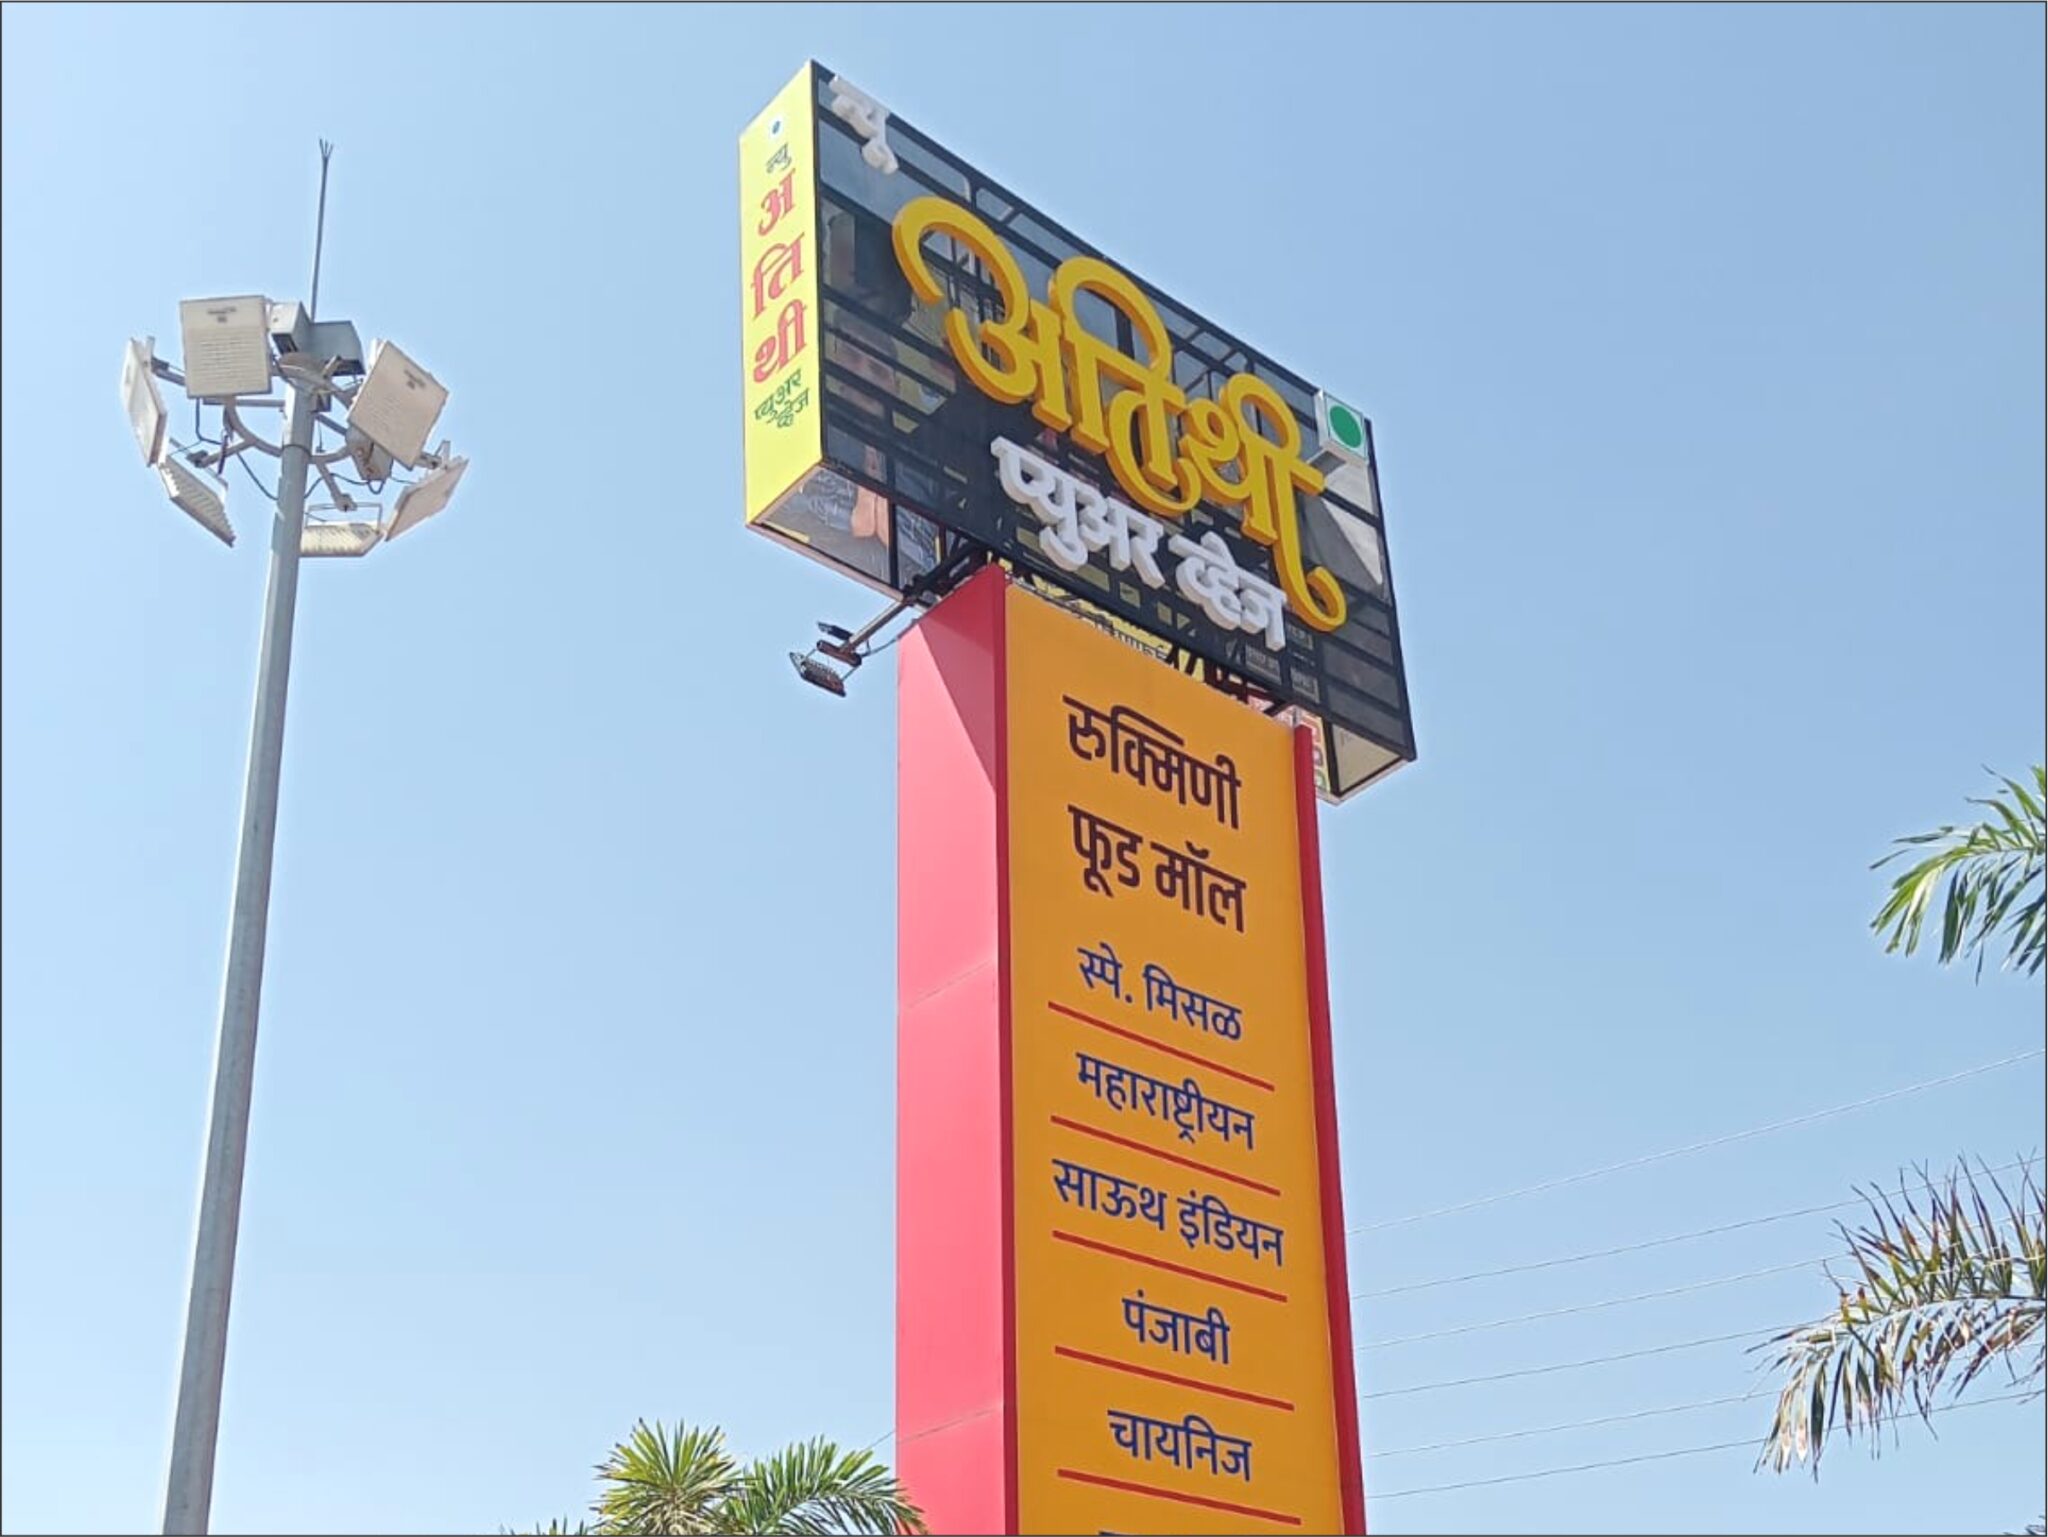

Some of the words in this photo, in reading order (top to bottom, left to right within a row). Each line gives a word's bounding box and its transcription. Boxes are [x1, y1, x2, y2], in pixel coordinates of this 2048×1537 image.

[892, 195, 1346, 631] अतिथी
[990, 435, 1165, 590] प्युअर
[1168, 531, 1288, 652] व्हेज
[1062, 694, 1243, 831] रुक्मिणी
[1067, 803, 1143, 899] फूड
[1150, 840, 1247, 934] मॉल
[1076, 942, 1134, 1005] स्पे.
[1143, 964, 1243, 1042] मिसळ
[1076, 1052, 1255, 1151] महाराष्ट्रीयन
[1052, 1158, 1167, 1232] साऊथ
[1177, 1188, 1285, 1267] इंडियन
[1122, 1289, 1231, 1366] पंजाबी
[1107, 1409, 1252, 1483] चायनिज
